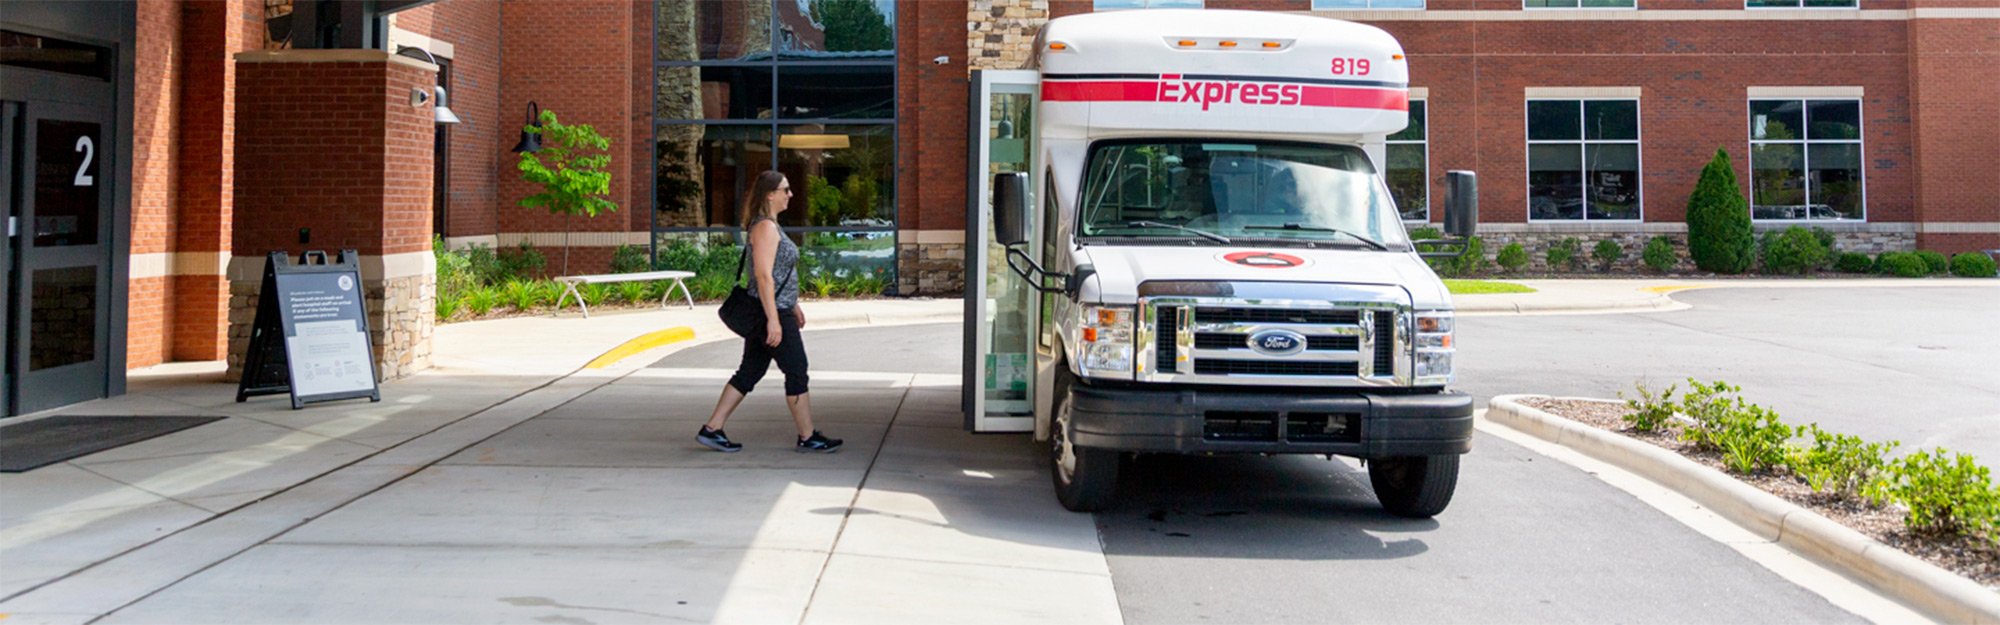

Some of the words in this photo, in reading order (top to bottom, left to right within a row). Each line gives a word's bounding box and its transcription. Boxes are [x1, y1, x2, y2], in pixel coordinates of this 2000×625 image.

[1331, 57, 1370, 76] 819
[1158, 73, 1300, 111] Express
[74, 135, 94, 186] 2
[1264, 335, 1291, 349] Ford
